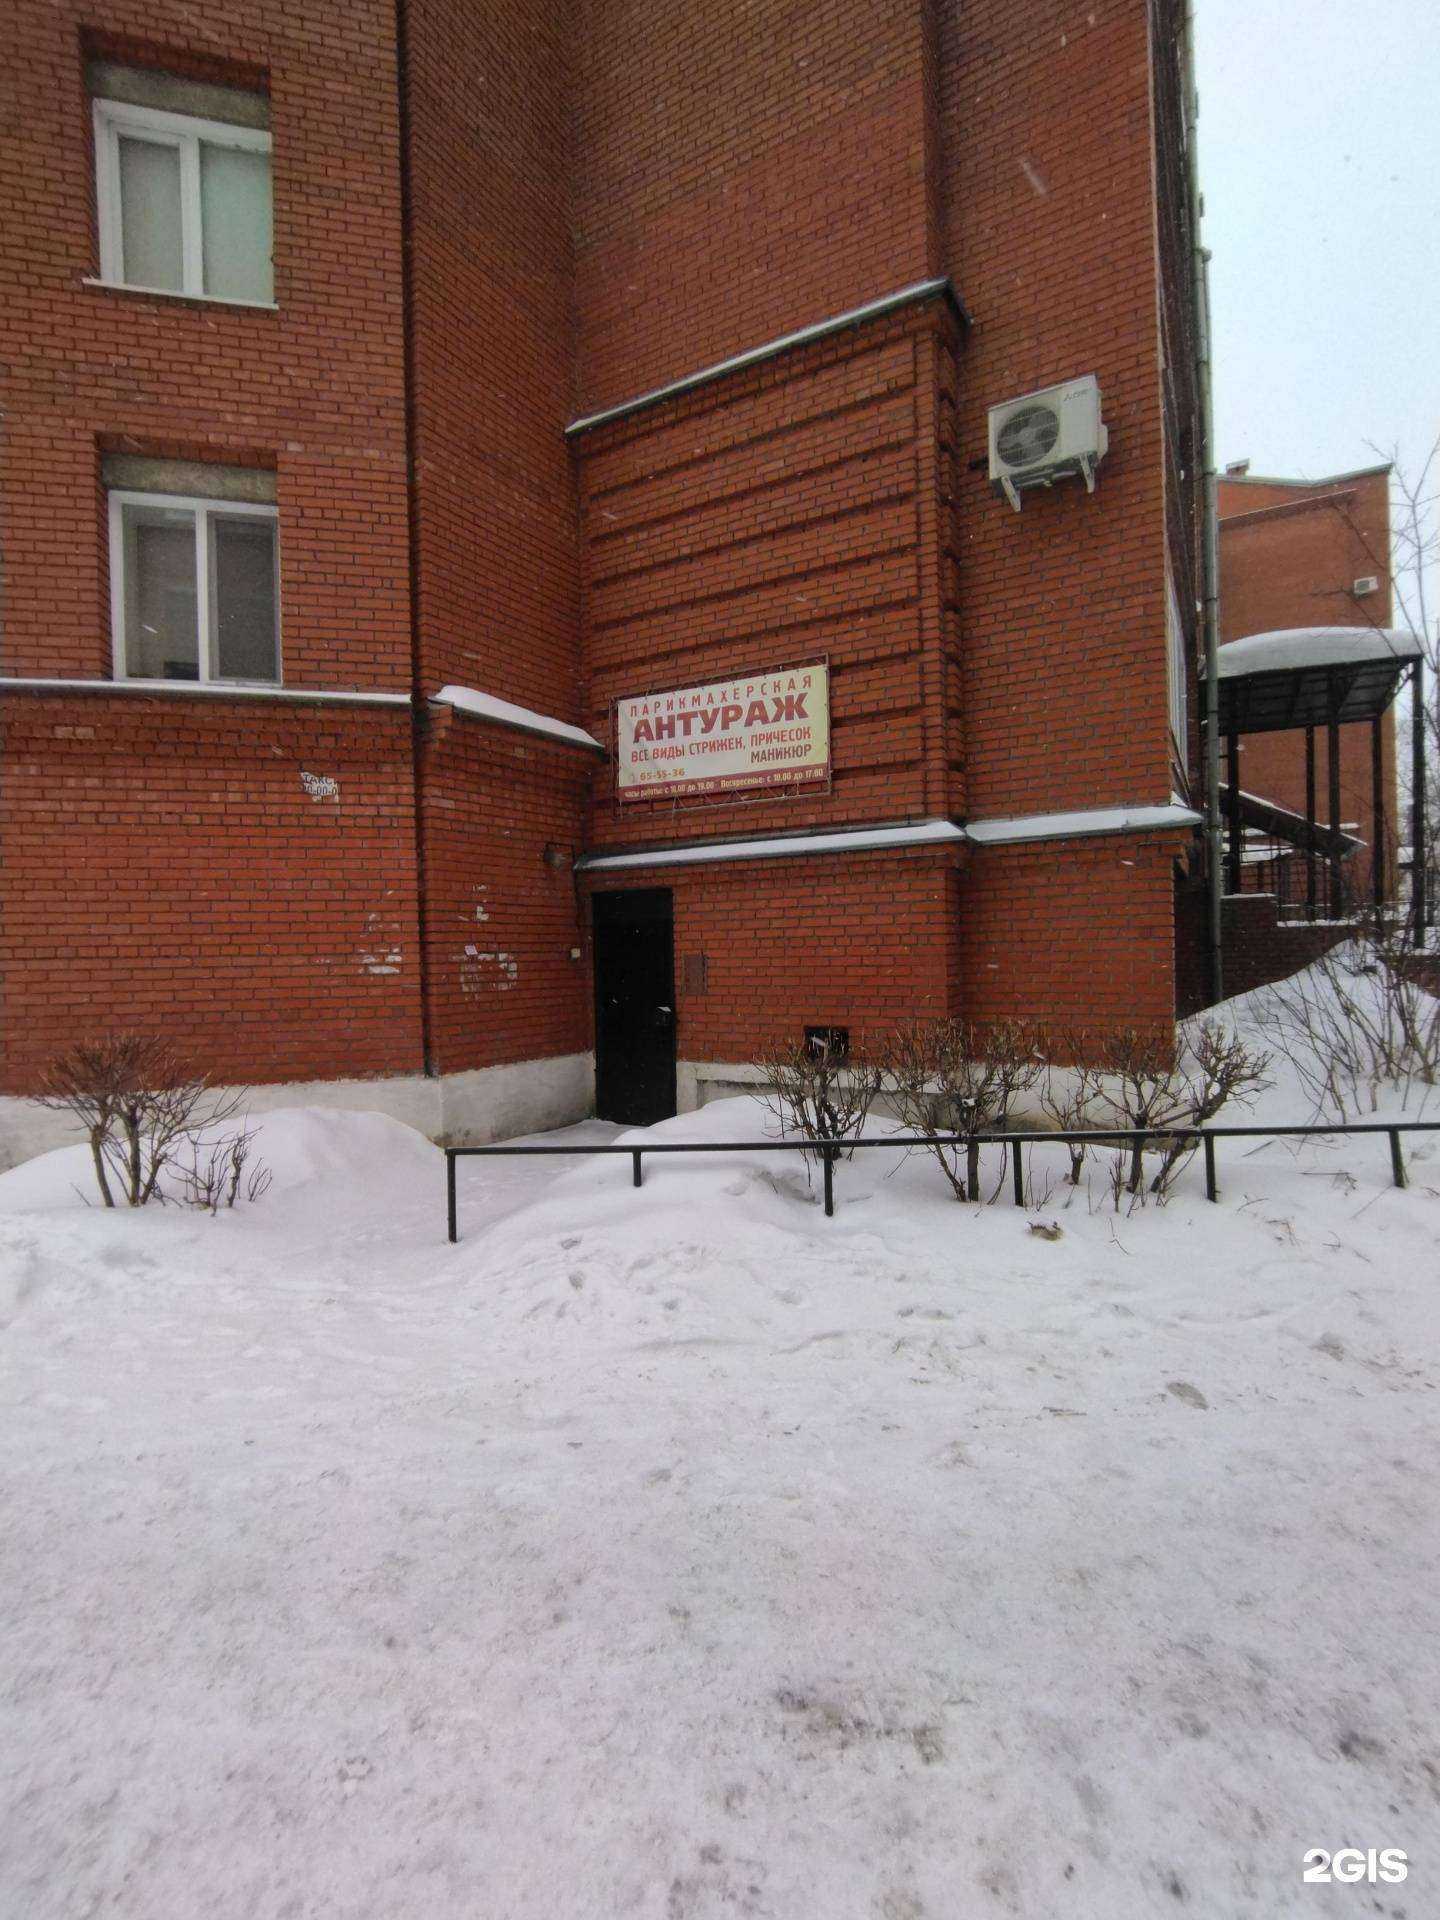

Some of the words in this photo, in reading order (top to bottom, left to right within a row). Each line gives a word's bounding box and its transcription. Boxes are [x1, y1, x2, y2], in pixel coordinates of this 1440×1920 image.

[630, 675, 812, 717] ПАРИКМАХЕРСКАЯ
[633, 692, 809, 743] АНТУРАЖ
[631, 748, 649, 763] ВСЕ
[652, 744, 685, 761] ВИДЫ
[689, 736, 746, 756] СТРИЖЕК,
[751, 726, 811, 747] ПРИЧЕСОК
[751, 743, 812, 763] МАНИКЮР
